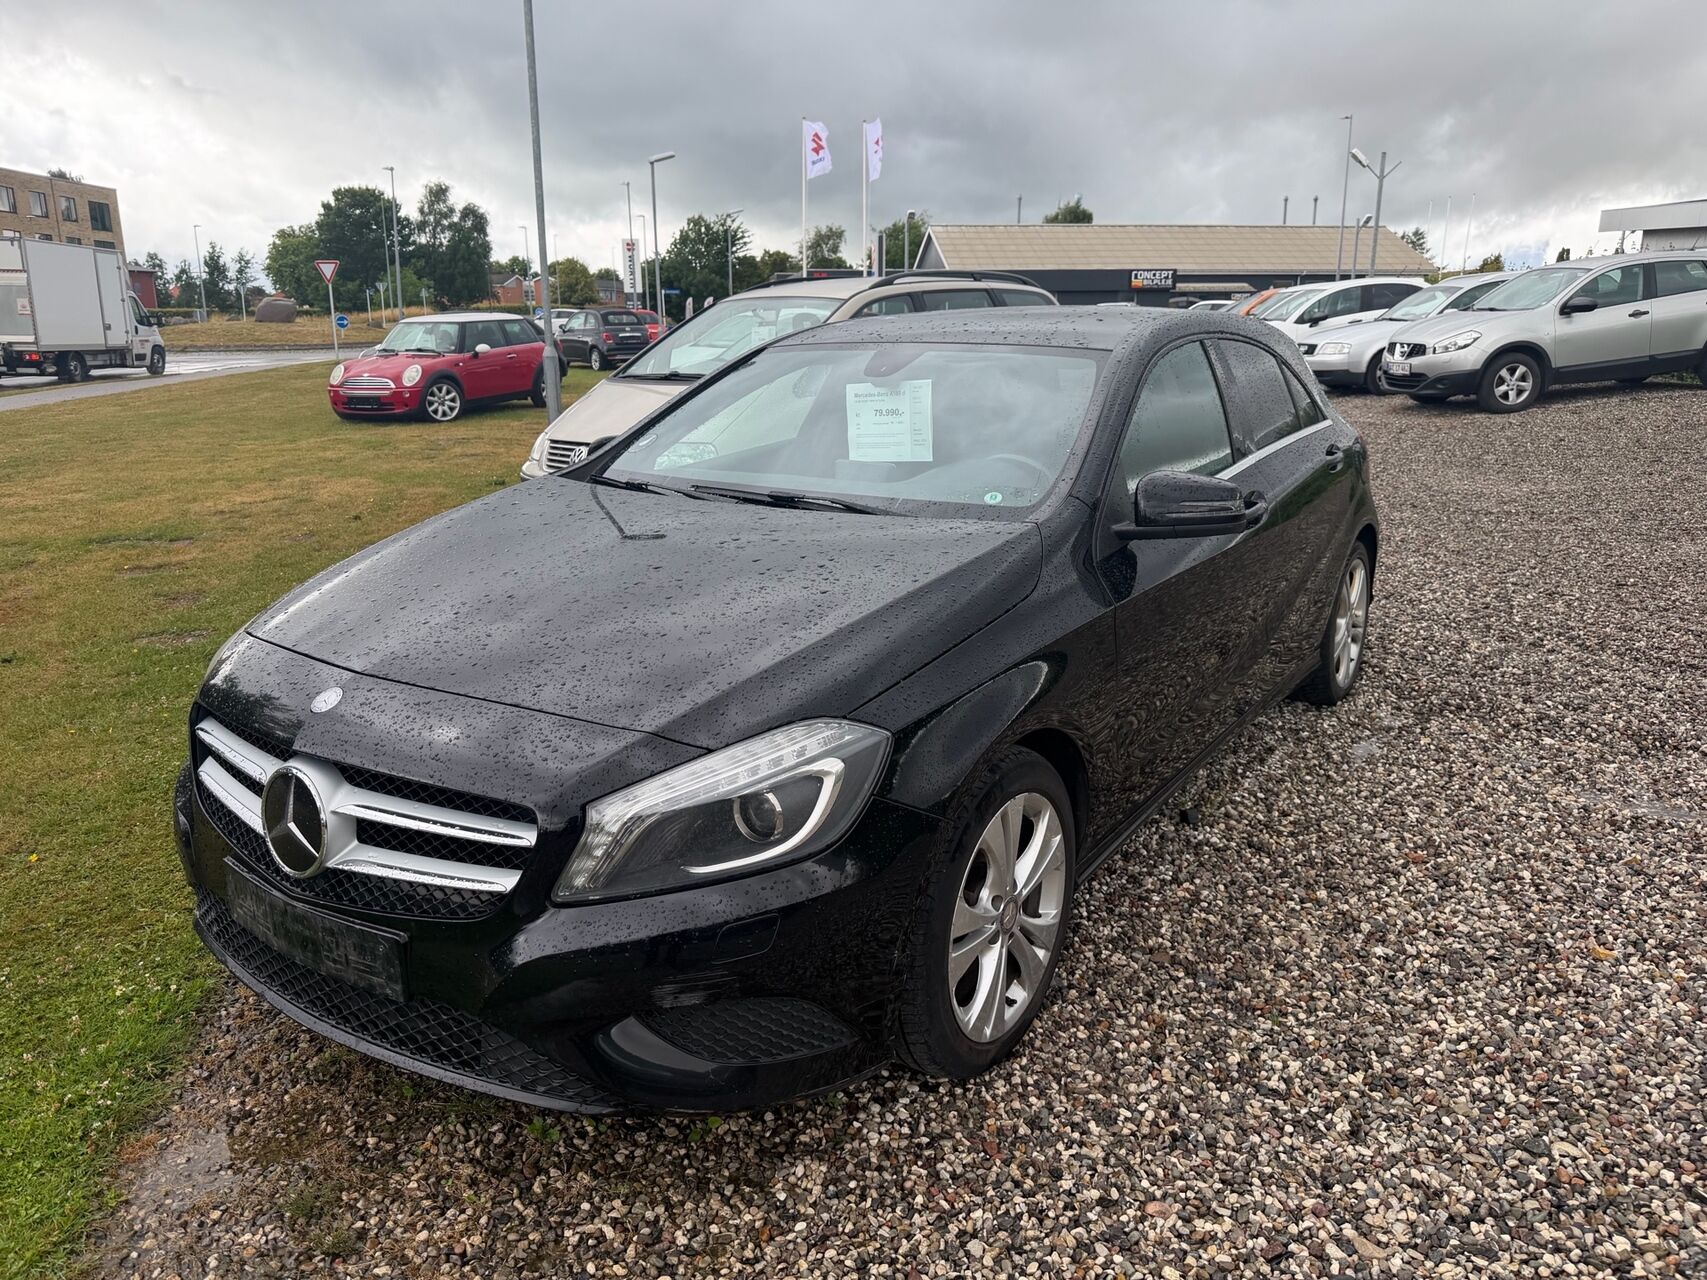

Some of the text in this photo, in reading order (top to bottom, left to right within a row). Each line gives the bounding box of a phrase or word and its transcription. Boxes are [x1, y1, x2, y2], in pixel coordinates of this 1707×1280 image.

[1131, 270, 1173, 281] CONCEPT
[854, 391, 888, 399] Mercedes-Benz
[873, 408, 905, 417] 79.990,-
